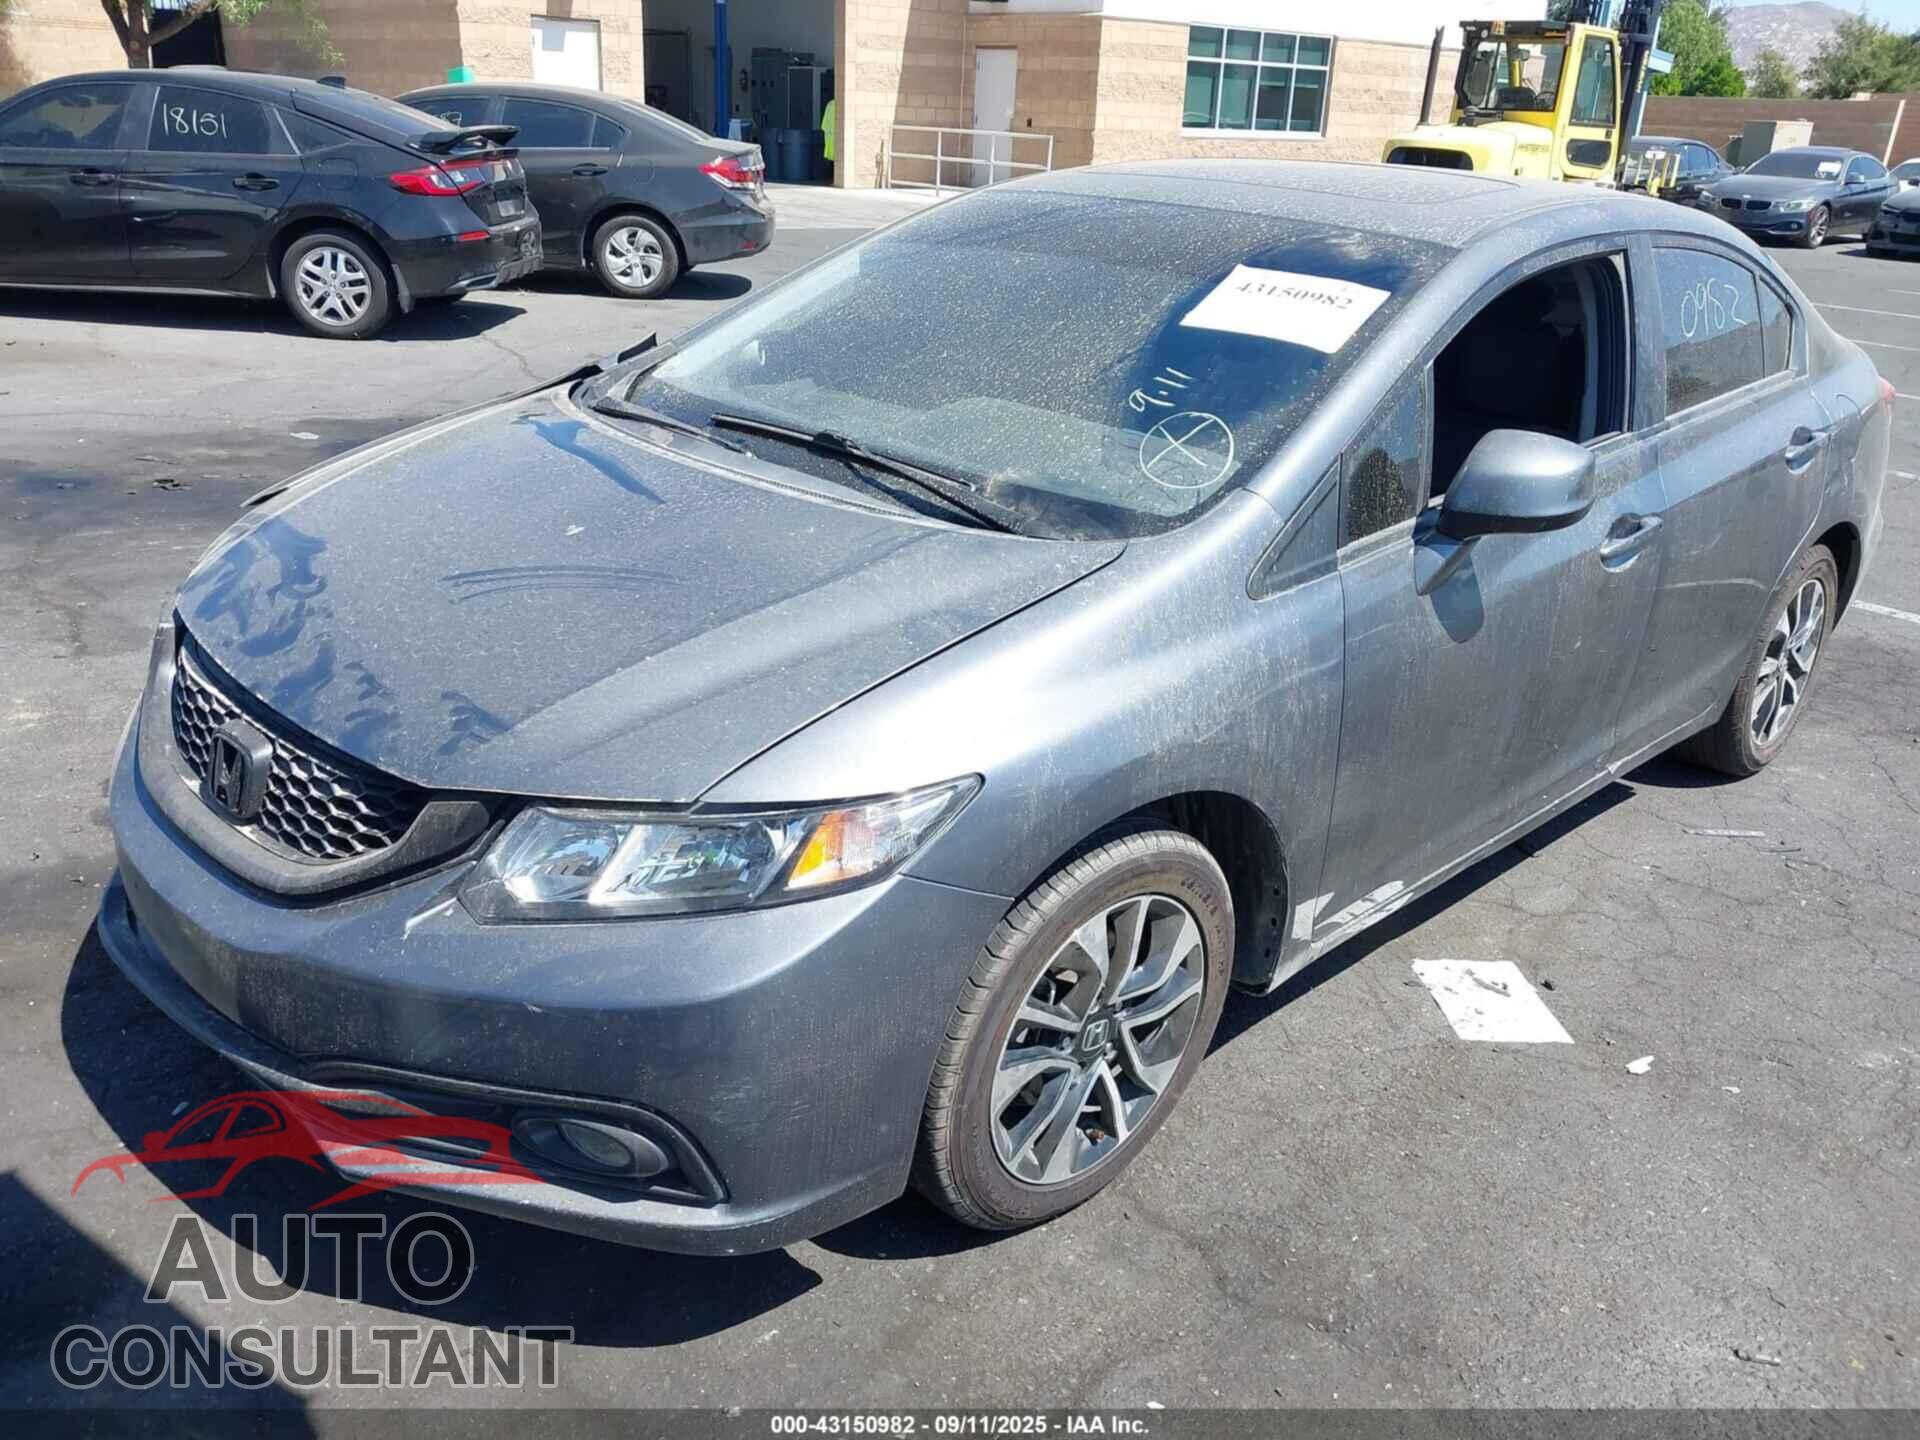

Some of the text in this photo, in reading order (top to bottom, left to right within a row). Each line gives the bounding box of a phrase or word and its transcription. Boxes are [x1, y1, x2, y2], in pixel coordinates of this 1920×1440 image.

[163, 103, 227, 139] 18151
[1236, 281, 1354, 310] 43150982
[1680, 277, 1747, 338] 0982
